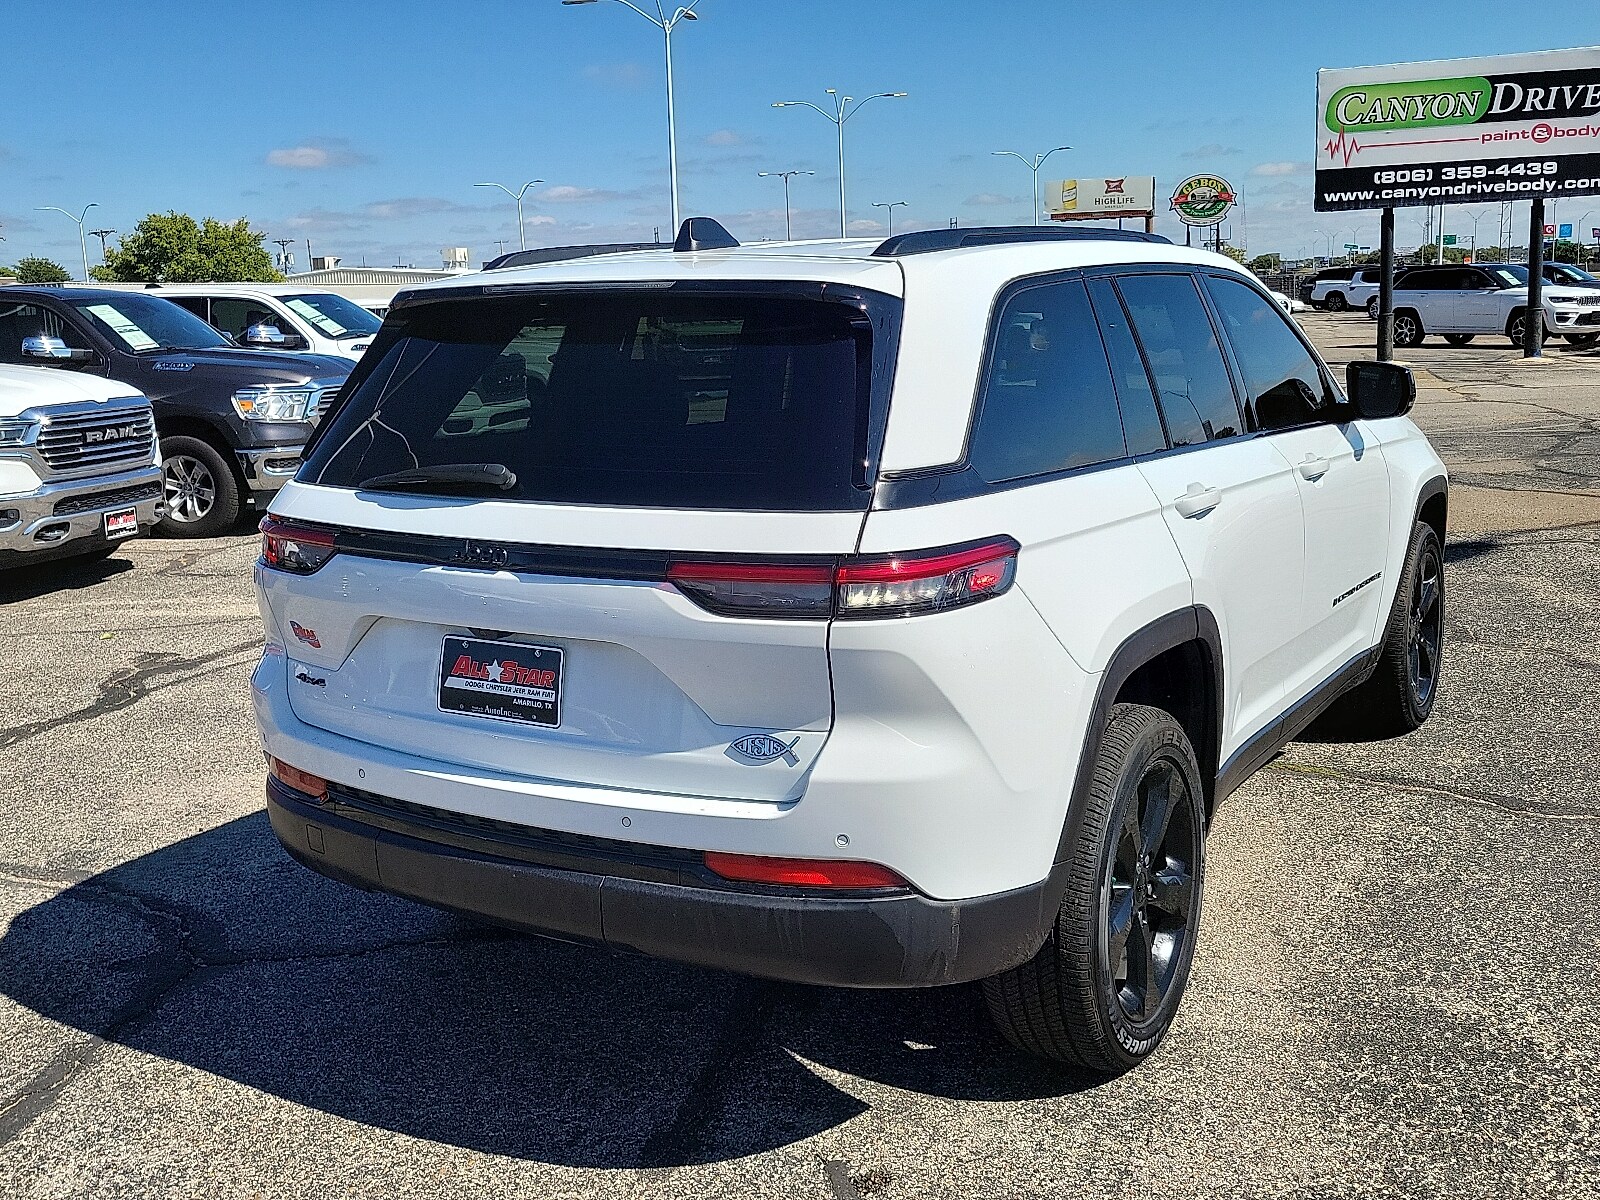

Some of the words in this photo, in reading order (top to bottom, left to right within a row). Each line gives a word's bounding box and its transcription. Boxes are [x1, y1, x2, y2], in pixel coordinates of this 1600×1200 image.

[1335, 91, 1483, 126] CANYON
[1488, 82, 1600, 115] DRIVE
[1481, 129, 1530, 144] paint
[1554, 124, 1600, 138] body
[1373, 168, 1433, 185] (806)
[1441, 161, 1558, 180] 359-4439
[1094, 197, 1116, 206] HIGH
[1117, 196, 1135, 205] LIFE
[85, 426, 137, 443] RAM
[450, 654, 490, 680] ALL
[500, 660, 556, 689] STAR
[464, 680, 485, 689] DODGE
[485, 683, 513, 693] CHRYSLER
[527, 689, 541, 697] RAM
[541, 690, 555, 699] FIAT
[512, 698, 544, 709] AMARILLO,
[544, 702, 553, 710] TX
